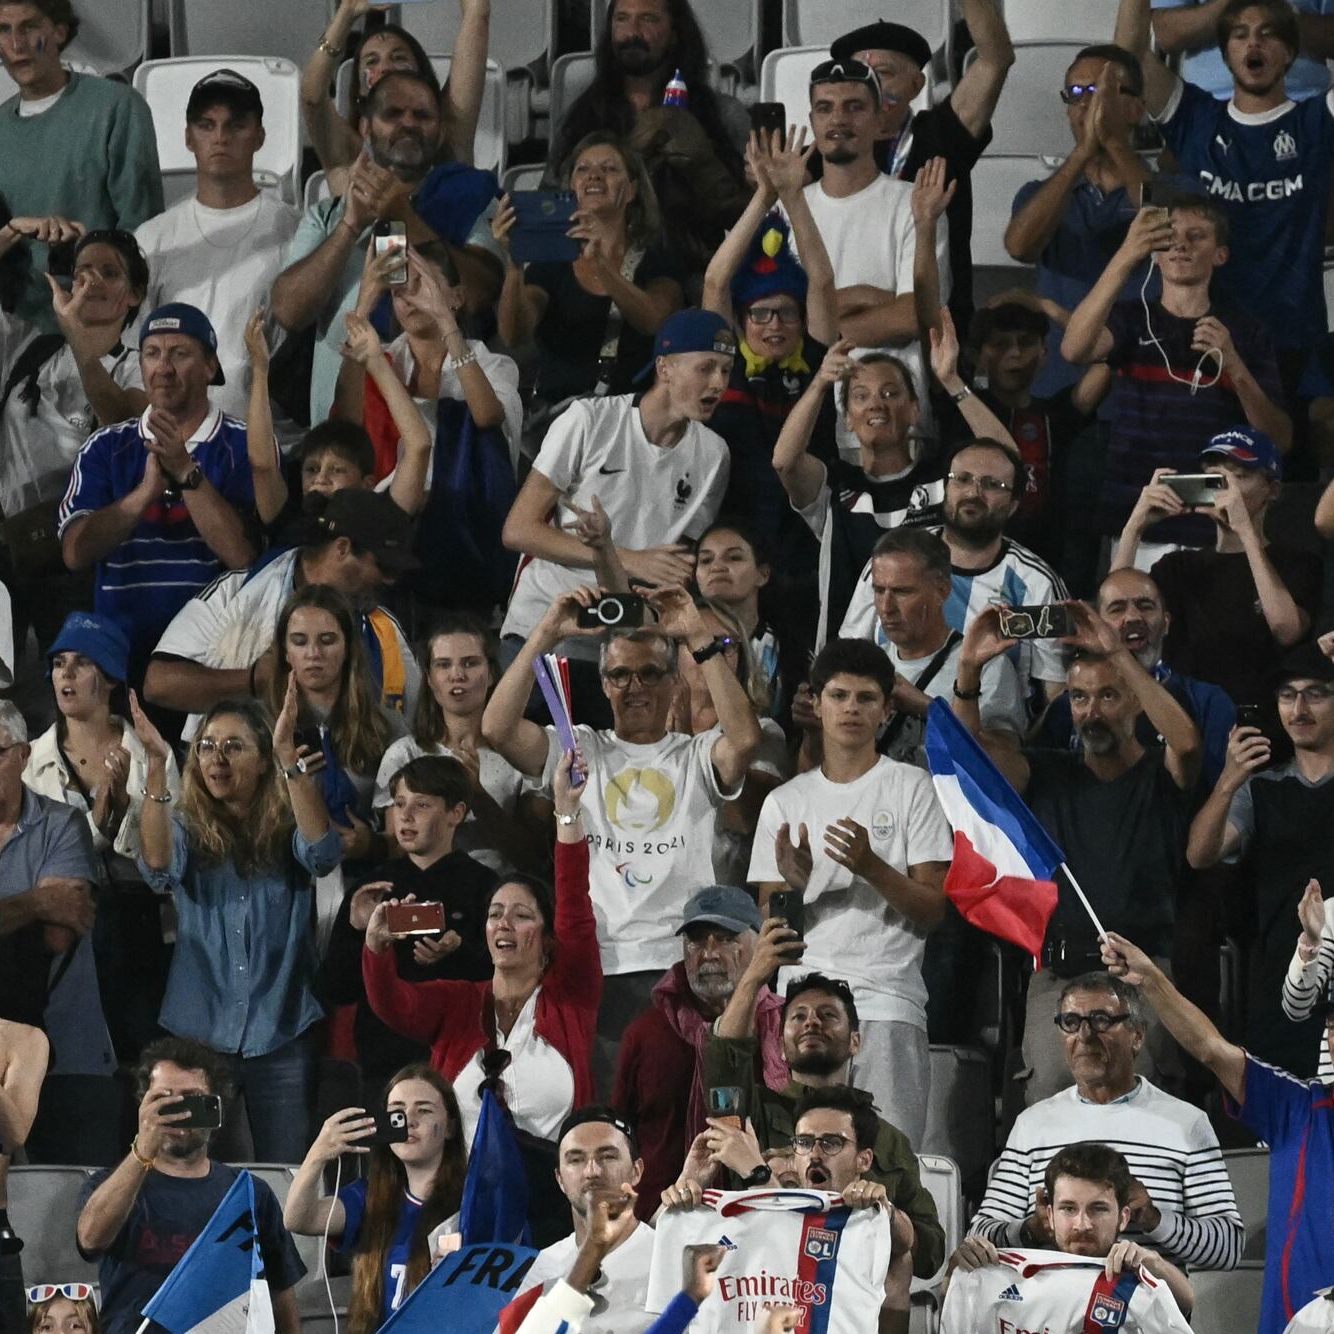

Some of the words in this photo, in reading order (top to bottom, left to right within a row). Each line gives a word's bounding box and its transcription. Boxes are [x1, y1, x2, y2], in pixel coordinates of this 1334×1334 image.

[1246, 175, 1304, 201] CGM
[719, 1269, 827, 1305] Emirates
[737, 1301, 758, 1322] FLY
